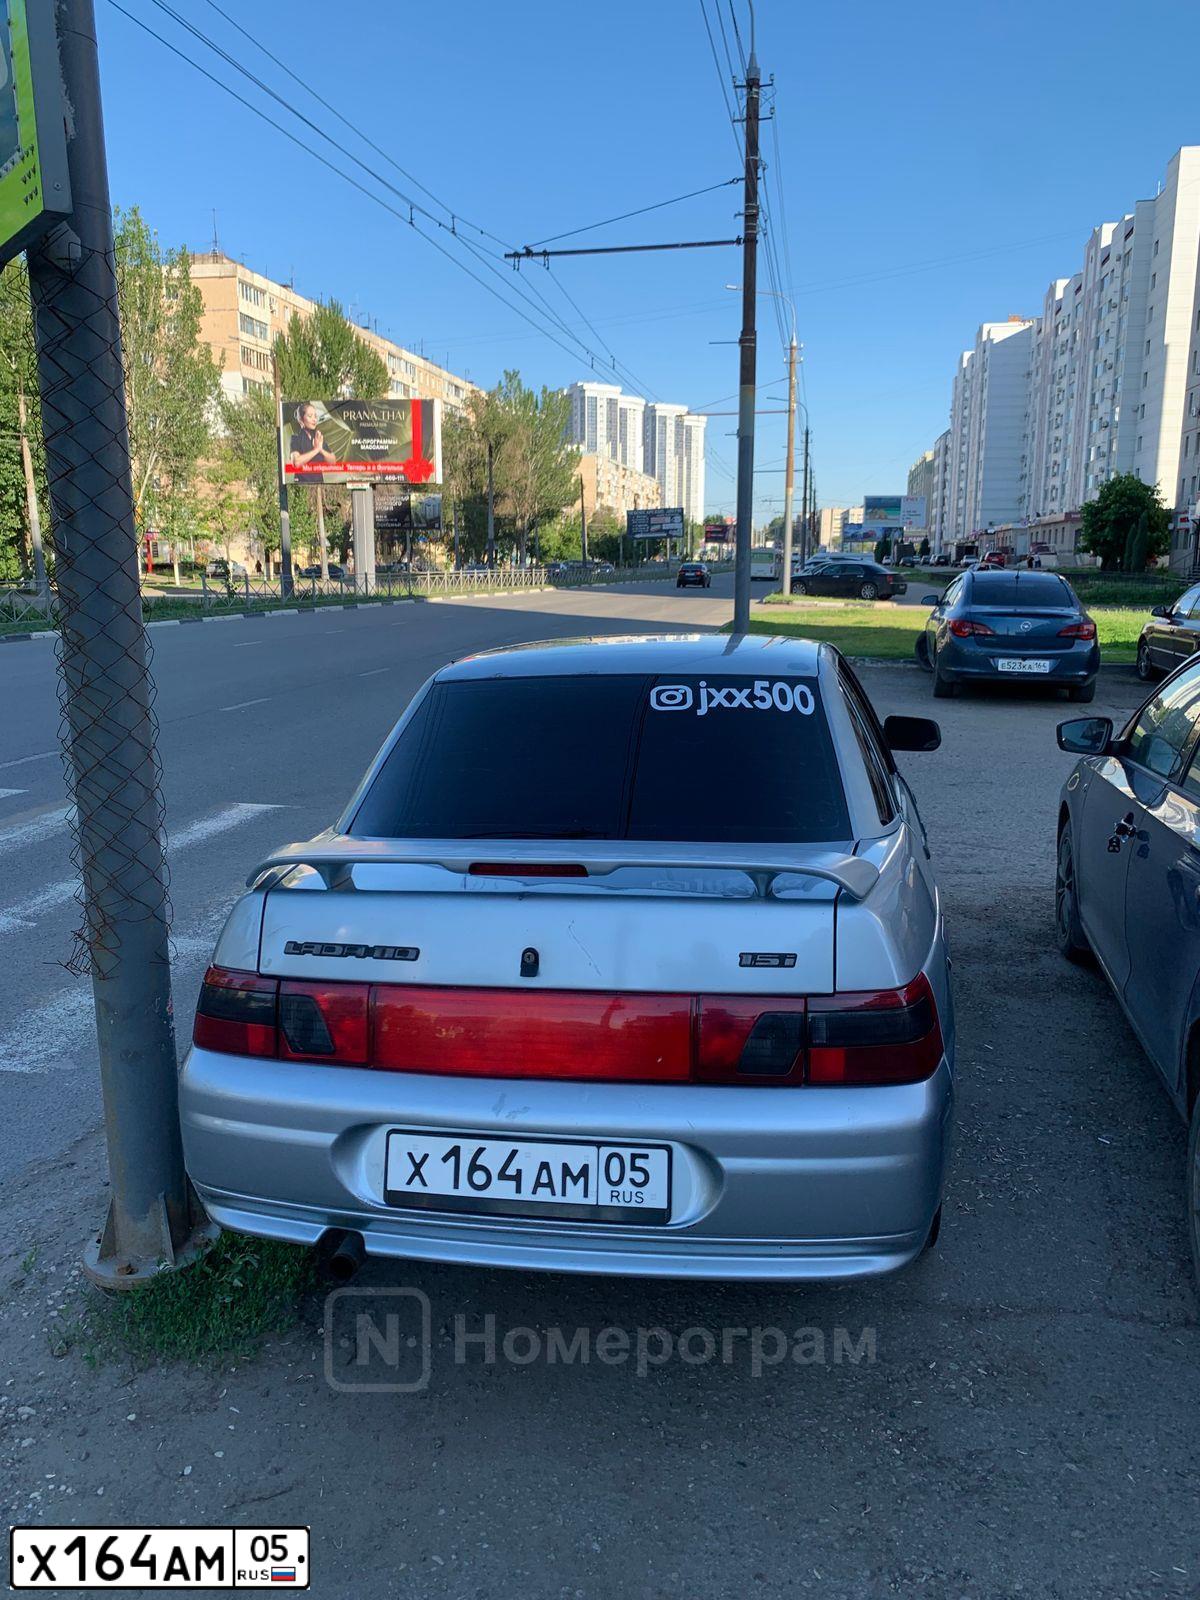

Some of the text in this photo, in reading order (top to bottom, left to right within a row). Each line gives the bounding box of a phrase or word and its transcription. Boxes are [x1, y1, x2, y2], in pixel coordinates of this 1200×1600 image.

[343, 410, 405, 421] PRANA THAI
[697, 680, 816, 716] jxx500
[285, 942, 367, 959] LADA
[406, 1145, 650, 1198] Х164АМ 05
[610, 1190, 645, 1204] RUS
